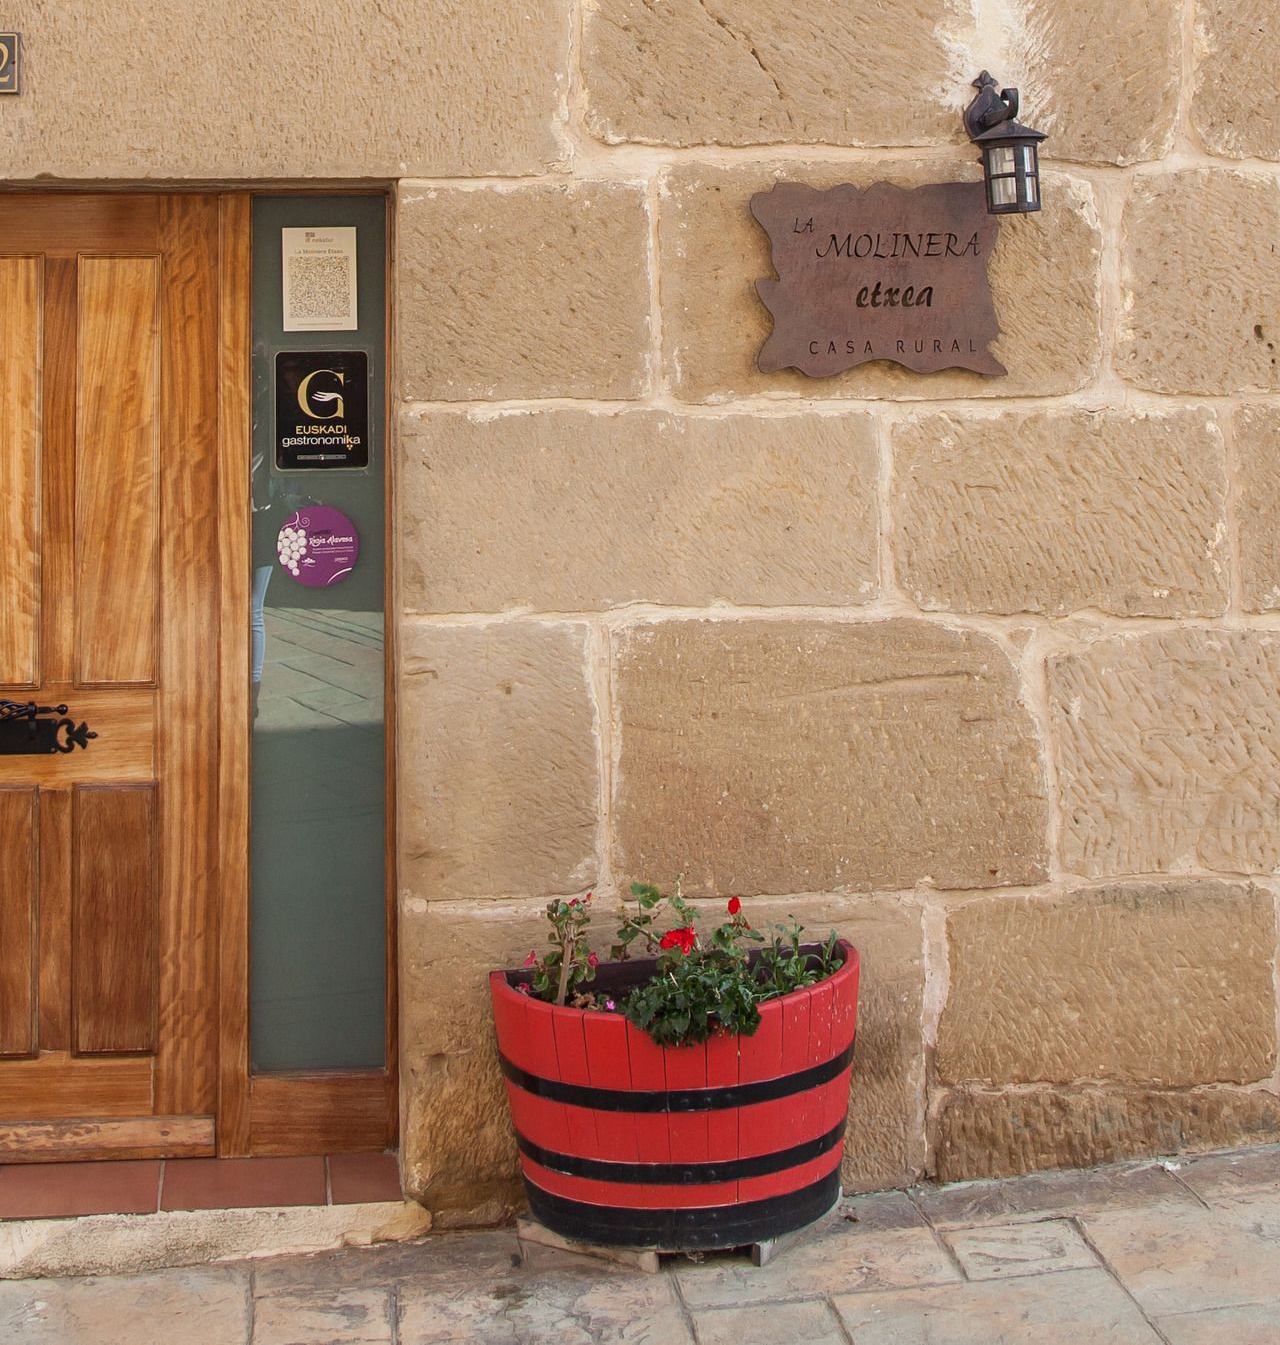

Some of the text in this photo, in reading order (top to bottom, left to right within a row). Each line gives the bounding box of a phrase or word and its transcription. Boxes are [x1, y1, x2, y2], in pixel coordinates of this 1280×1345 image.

[793, 217, 982, 259] LA MOLINERA
[855, 281, 934, 308] etxea
[808, 338, 977, 355] CASA RURAL
[295, 424, 347, 435] EUSKADI
[282, 435, 361, 448] gastronomika
[308, 535, 353, 547] Rioja Alavesa
